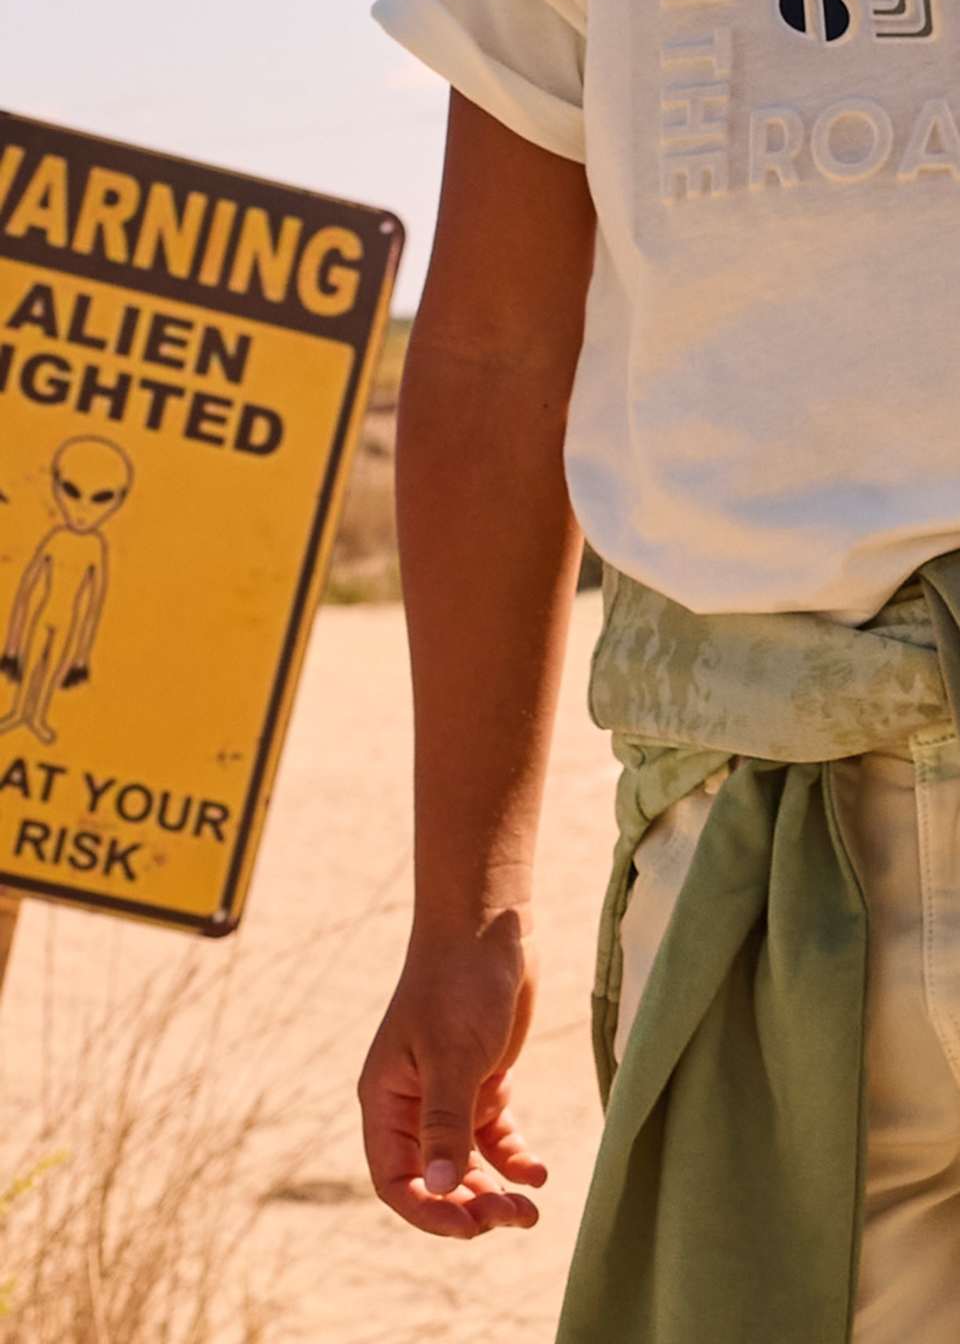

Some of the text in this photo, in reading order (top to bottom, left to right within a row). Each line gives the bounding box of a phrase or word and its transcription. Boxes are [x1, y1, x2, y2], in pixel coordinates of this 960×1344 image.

[660, 27, 731, 206] THE
[6, 281, 252, 384] ALIEN
[0, 757, 230, 843] AT YOUR
[15, 819, 142, 882] RISK
